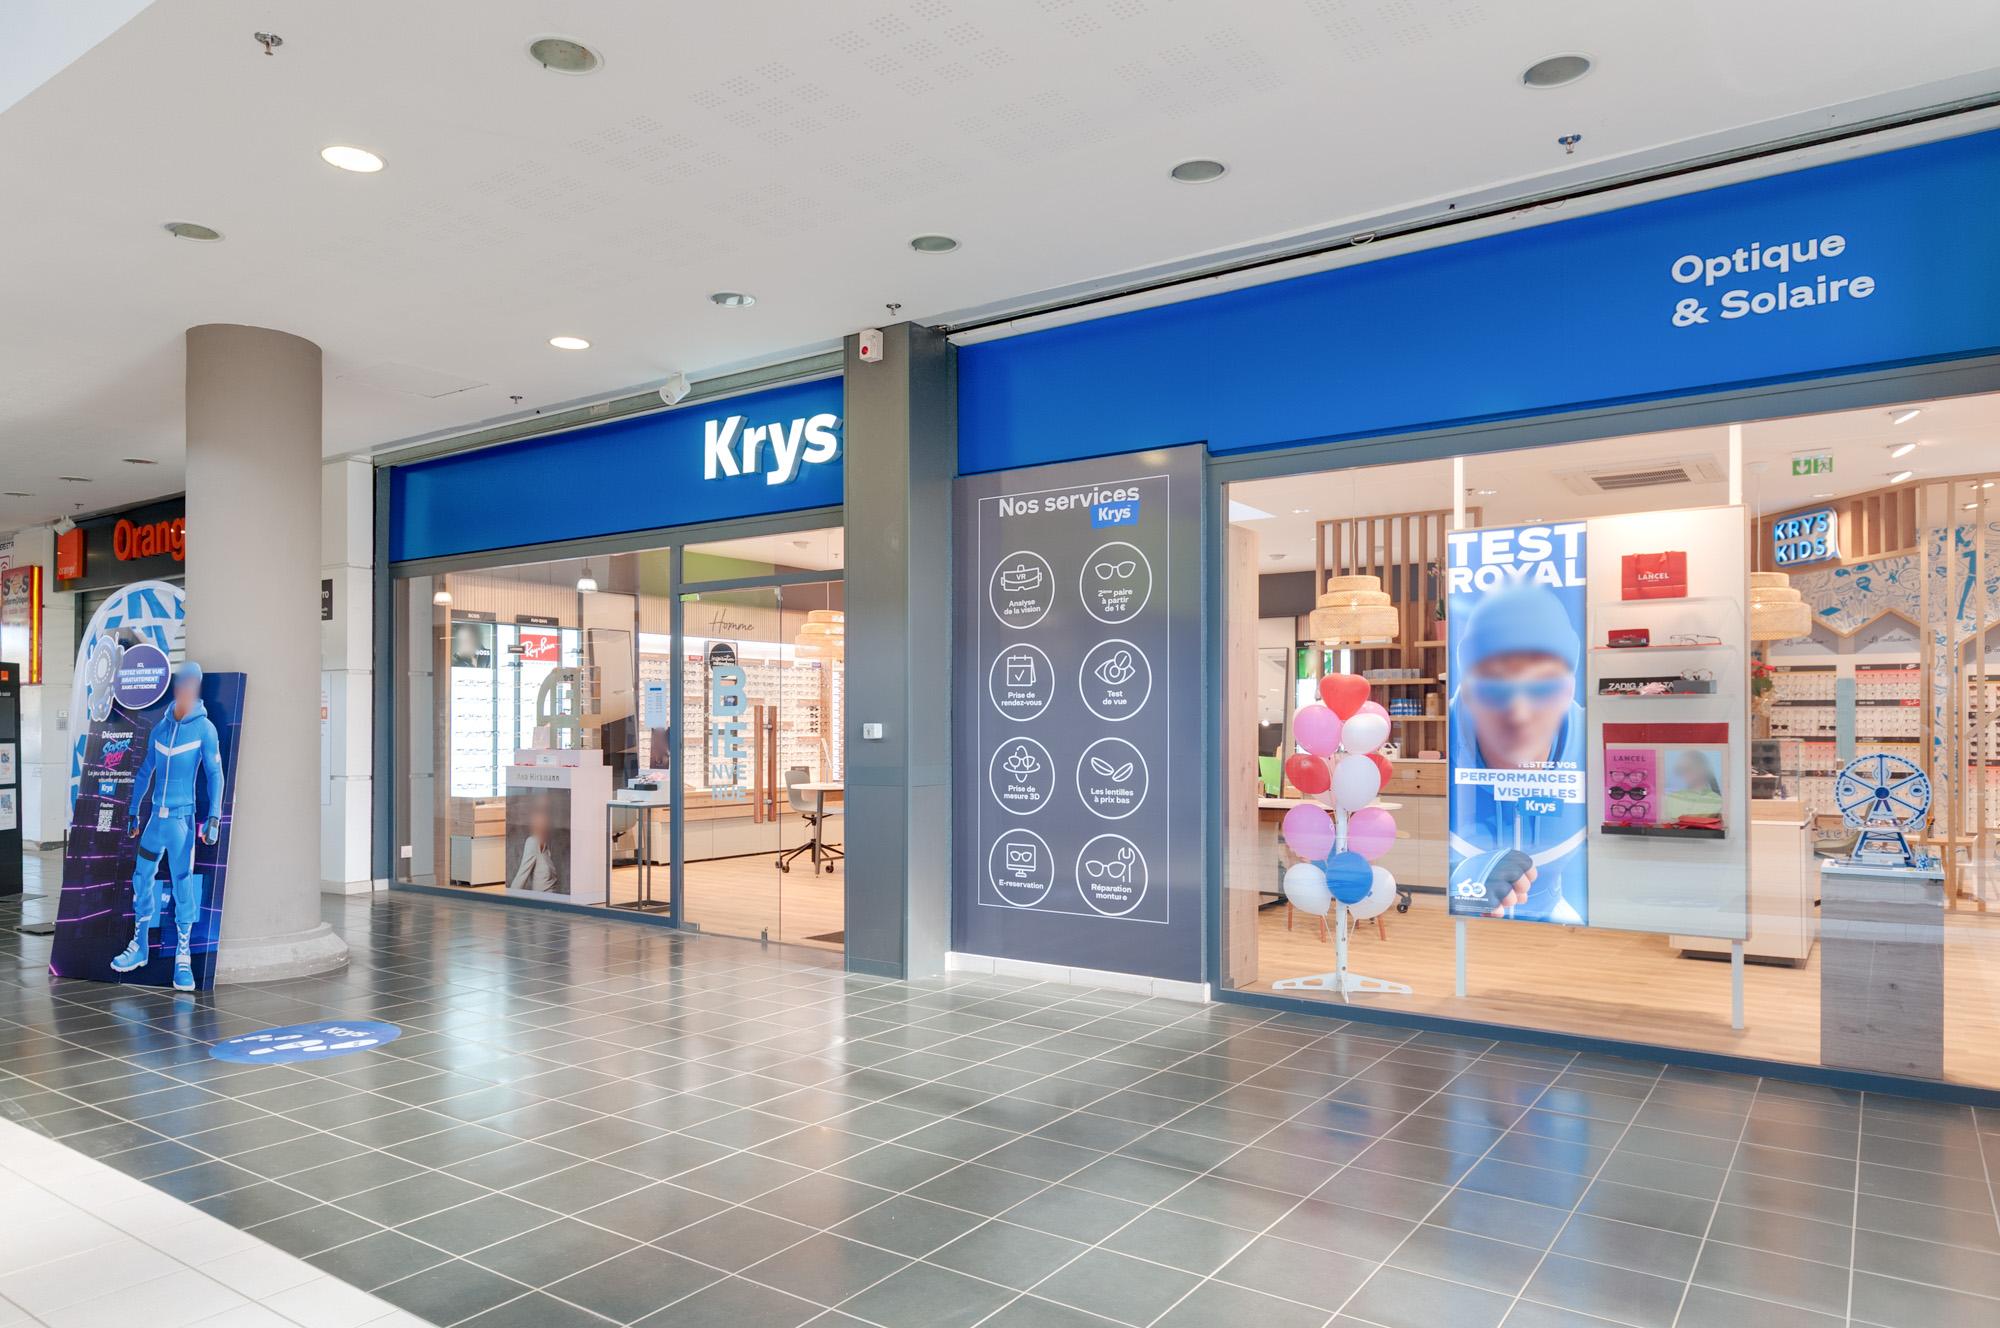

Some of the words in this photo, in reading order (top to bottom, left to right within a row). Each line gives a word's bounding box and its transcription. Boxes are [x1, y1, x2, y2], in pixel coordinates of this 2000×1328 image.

[1671, 235, 1846, 286] Optique
[1671, 298, 1710, 327] &
[1720, 275, 1875, 319] Solaire
[704, 413, 842, 485] Krys
[999, 497, 1039, 517] Nos
[1044, 487, 1139, 512] services
[1098, 506, 1131, 522] Krys
[1774, 514, 1828, 541] KRYS
[113, 518, 186, 560] Orang
[1448, 523, 1586, 567] TEST
[1776, 538, 1826, 562] KIDS
[1448, 559, 1586, 594] ROYAL
[1638, 572, 1670, 581] LANCEL
[1113, 588, 1133, 598] paire
[1009, 600, 1036, 608] Analyse
[1108, 596, 1130, 606] partir
[1105, 603, 1115, 612] de
[709, 608, 754, 634] Homme
[520, 637, 556, 658] Ray-Ban
[1608, 682, 1636, 690] ZADIG
[102, 731, 133, 739] Découvrez
[1556, 761, 1577, 769] VOS
[1460, 772, 1577, 783] PERFORMANCES
[101, 784, 113, 793] Krys
[1105, 788, 1134, 796] lentilles
[1498, 787, 1577, 799] VISUELLES
[1094, 795, 1099, 803] à
[1100, 796, 1115, 804] prix
[1116, 796, 1130, 804] bas
[1525, 800, 1556, 814] Krys
[998, 879, 1044, 890] E-reservation
[1091, 882, 1132, 893] Réparation
